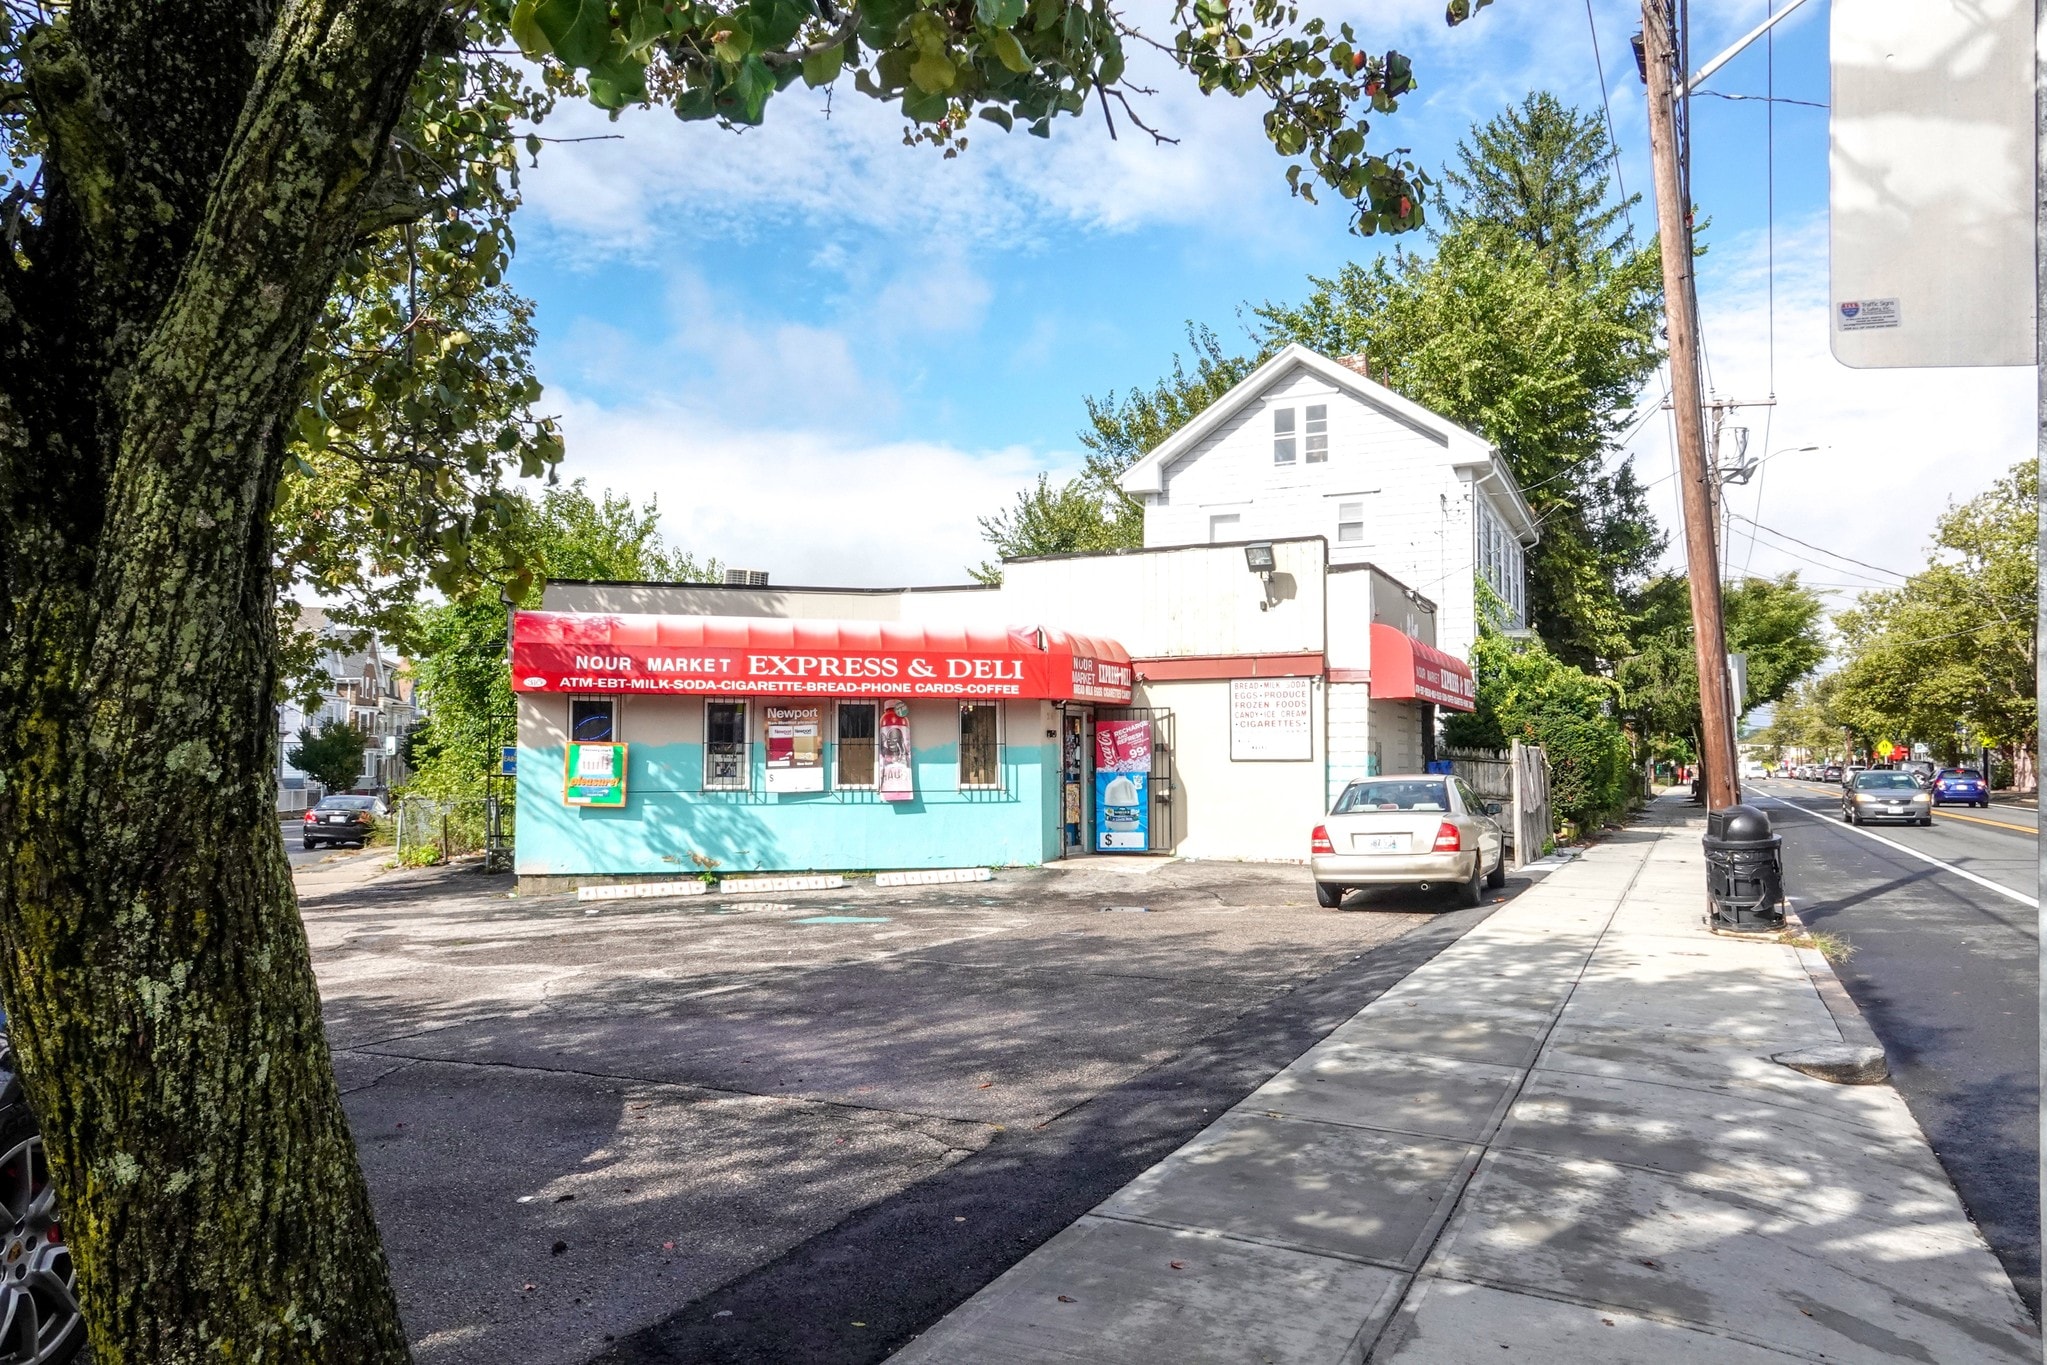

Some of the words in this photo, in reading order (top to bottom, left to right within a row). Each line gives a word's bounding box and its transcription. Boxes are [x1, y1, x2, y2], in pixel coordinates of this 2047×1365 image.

[575, 655, 632, 671] NOUR
[647, 657, 731, 672] MARKET
[747, 655, 899, 677] EXPRESS
[907, 658, 937, 678] &
[946, 658, 1025, 680] DELI
[1073, 656, 1093, 672] NOUR
[1072, 670, 1096, 686] MARKET
[559, 677, 911, 693] ATM-EBT-MILK-SODA-CIGARETTE-BREAD-PHONE
[915, 683, 1019, 694] CARDS-COFFEE
[1234, 682, 1259, 690] BREAD
[1263, 681, 1281, 689] MILK
[1264, 690, 1306, 698] PRODUCE
[1235, 701, 1270, 709] FROZEN
[1276, 700, 1307, 708] FOODS
[767, 708, 818, 719] Newport
[1234, 711, 1258, 719] CANDY
[1264, 710, 1275, 718] ICE
[1281, 710, 1307, 718] CREAM
[1240, 720, 1302, 728] CIGARETTES
[769, 774, 774, 782] $
[1104, 833, 1113, 847] $
